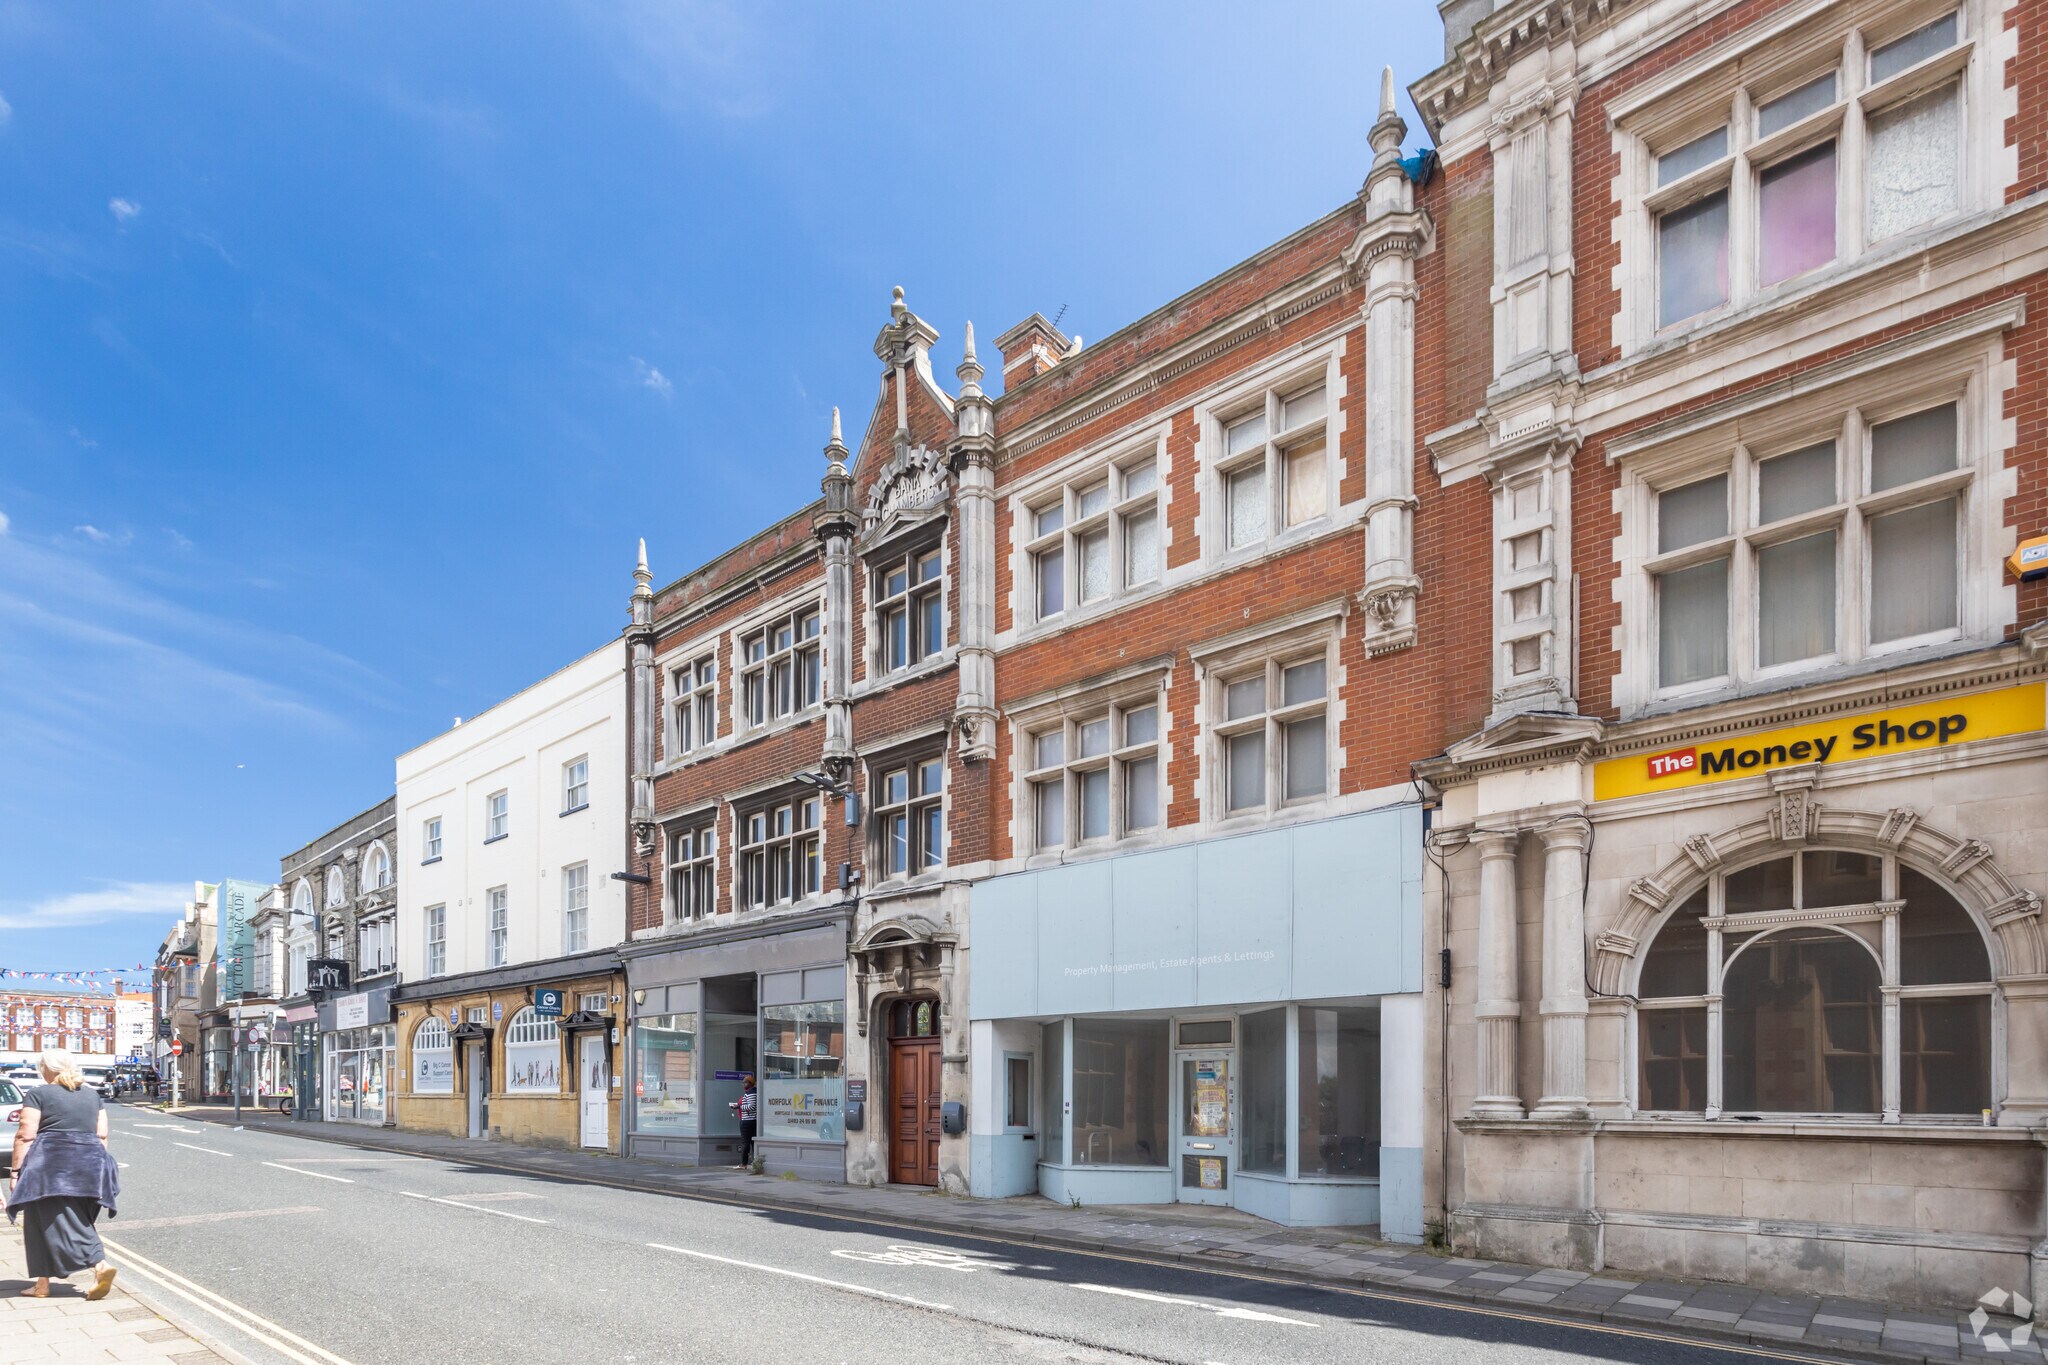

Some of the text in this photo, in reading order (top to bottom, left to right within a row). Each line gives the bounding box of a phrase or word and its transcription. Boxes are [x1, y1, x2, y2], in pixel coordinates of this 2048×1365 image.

[894, 471, 921, 499] BANK
[2023, 546, 2048, 560] ADT
[1651, 713, 1967, 775] The Money Shop
[233, 892, 245, 997] VICTORIA ARCADE
[1064, 949, 1275, 977] Property Management, Estate Agents & Lettings
[658, 1081, 668, 1092] 24
[768, 1098, 792, 1106] NORFOLK
[813, 1098, 838, 1107] FINANCE
